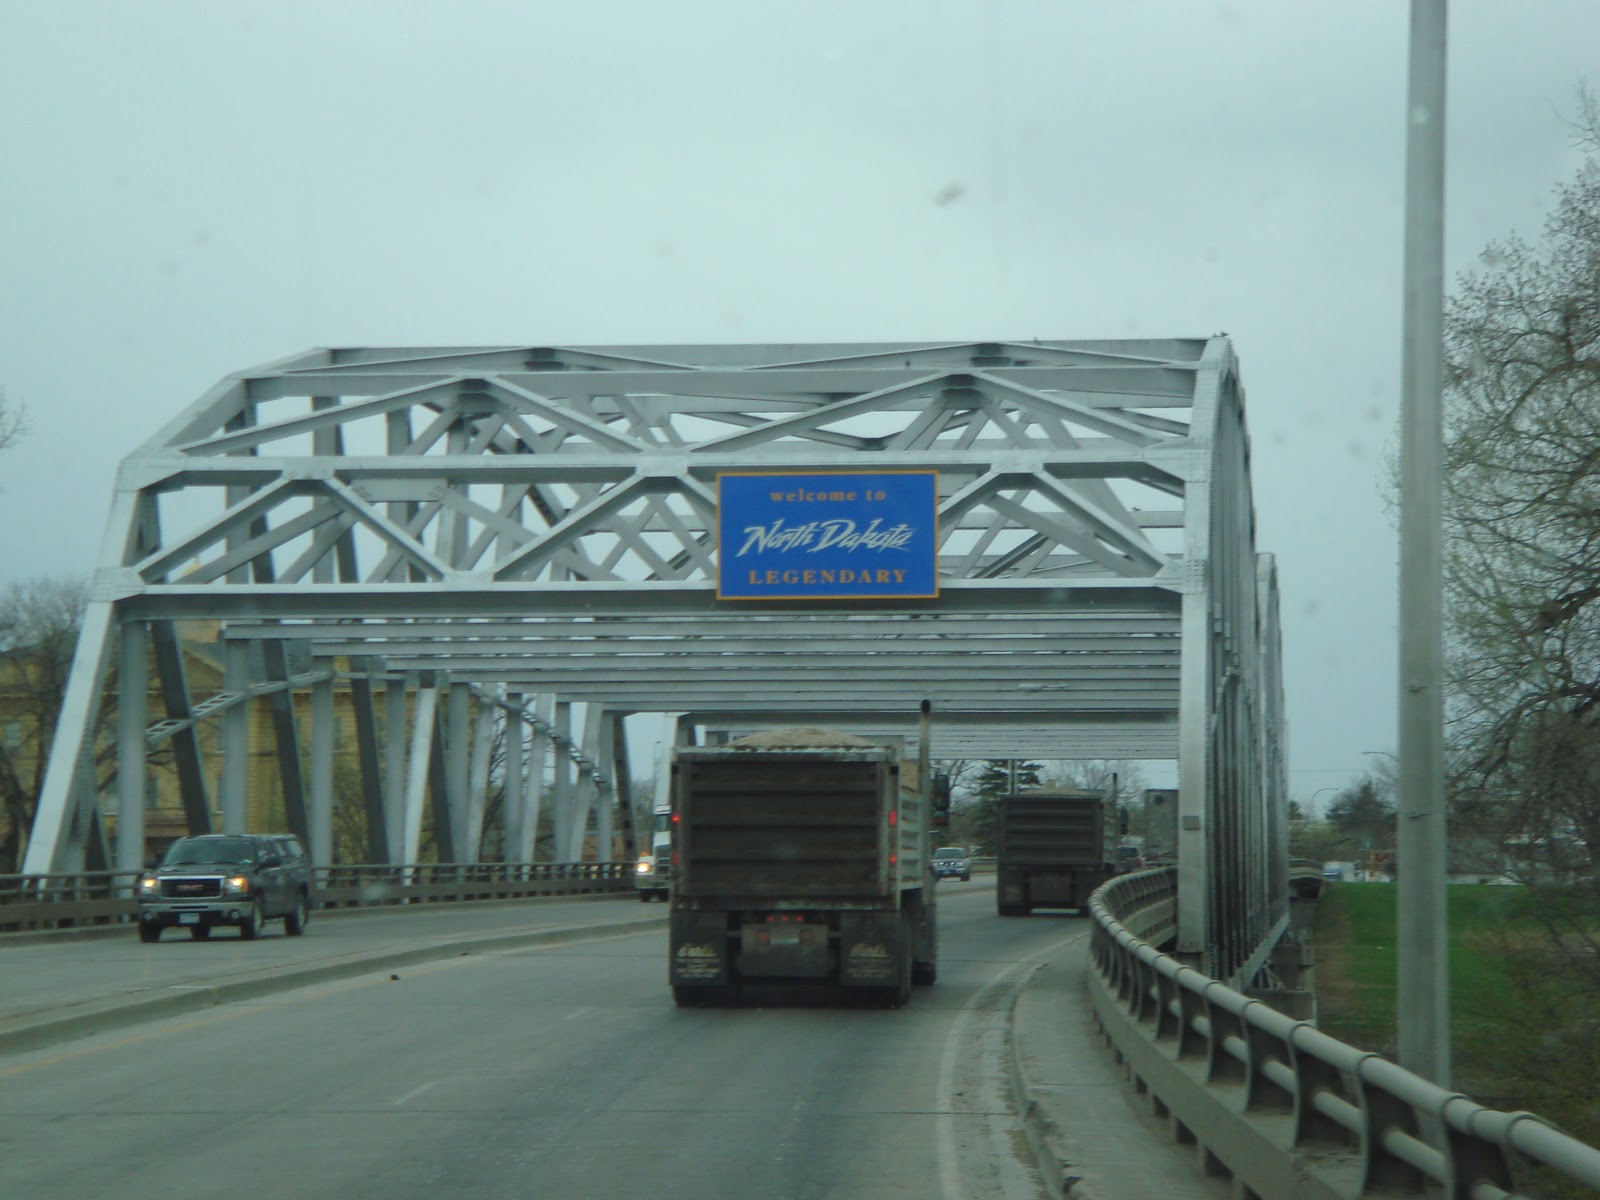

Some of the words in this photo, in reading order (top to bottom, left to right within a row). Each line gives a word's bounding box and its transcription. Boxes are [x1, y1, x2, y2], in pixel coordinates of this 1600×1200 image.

[769, 488, 857, 502] welcome
[865, 489, 886, 501] to
[735, 518, 821, 557] North
[806, 518, 917, 553] Dakota
[748, 569, 907, 585] LEGENDARY
